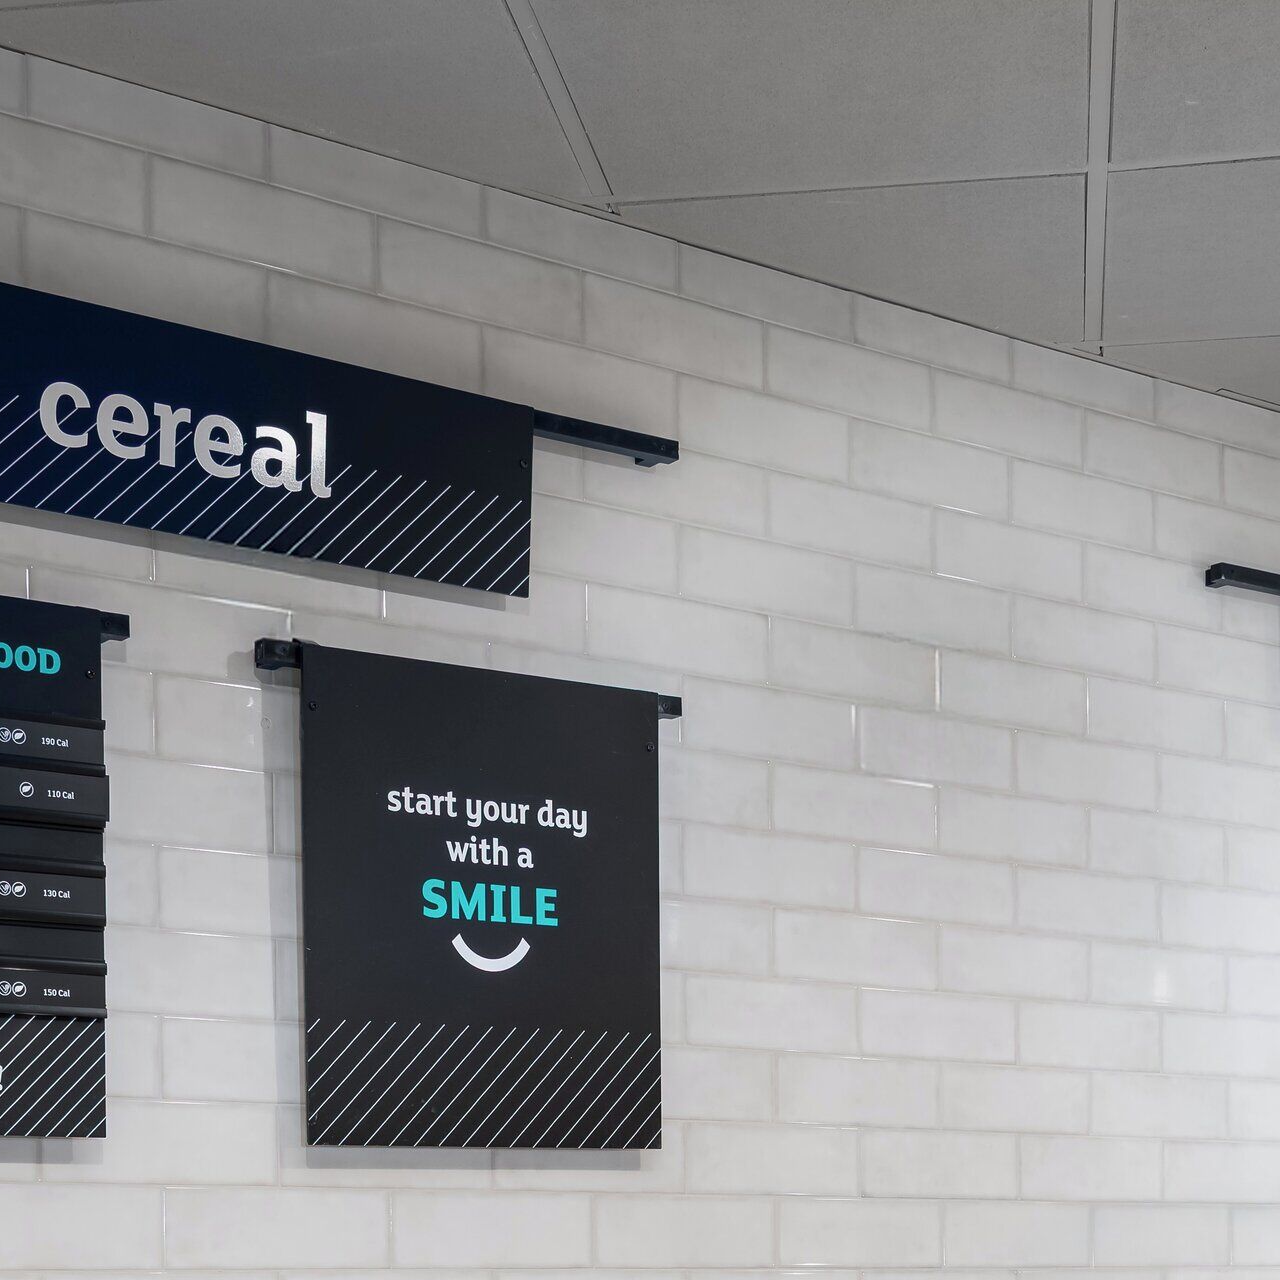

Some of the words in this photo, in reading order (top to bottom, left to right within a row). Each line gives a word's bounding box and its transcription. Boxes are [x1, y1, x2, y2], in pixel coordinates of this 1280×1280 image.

[39, 380, 333, 499] cereal
[41, 737, 55, 746] 190
[56, 738, 69, 748] Cal
[47, 789, 61, 799] 110
[62, 791, 75, 800] Cal
[387, 786, 458, 818] start
[465, 798, 530, 828] your
[537, 799, 588, 838] day
[445, 835, 509, 867] with
[517, 847, 535, 869] a
[43, 889, 57, 898] 130
[58, 890, 71, 899] Cal
[421, 878, 559, 927] SMILE
[43, 988, 57, 998] 150
[58, 989, 71, 998] Cal
